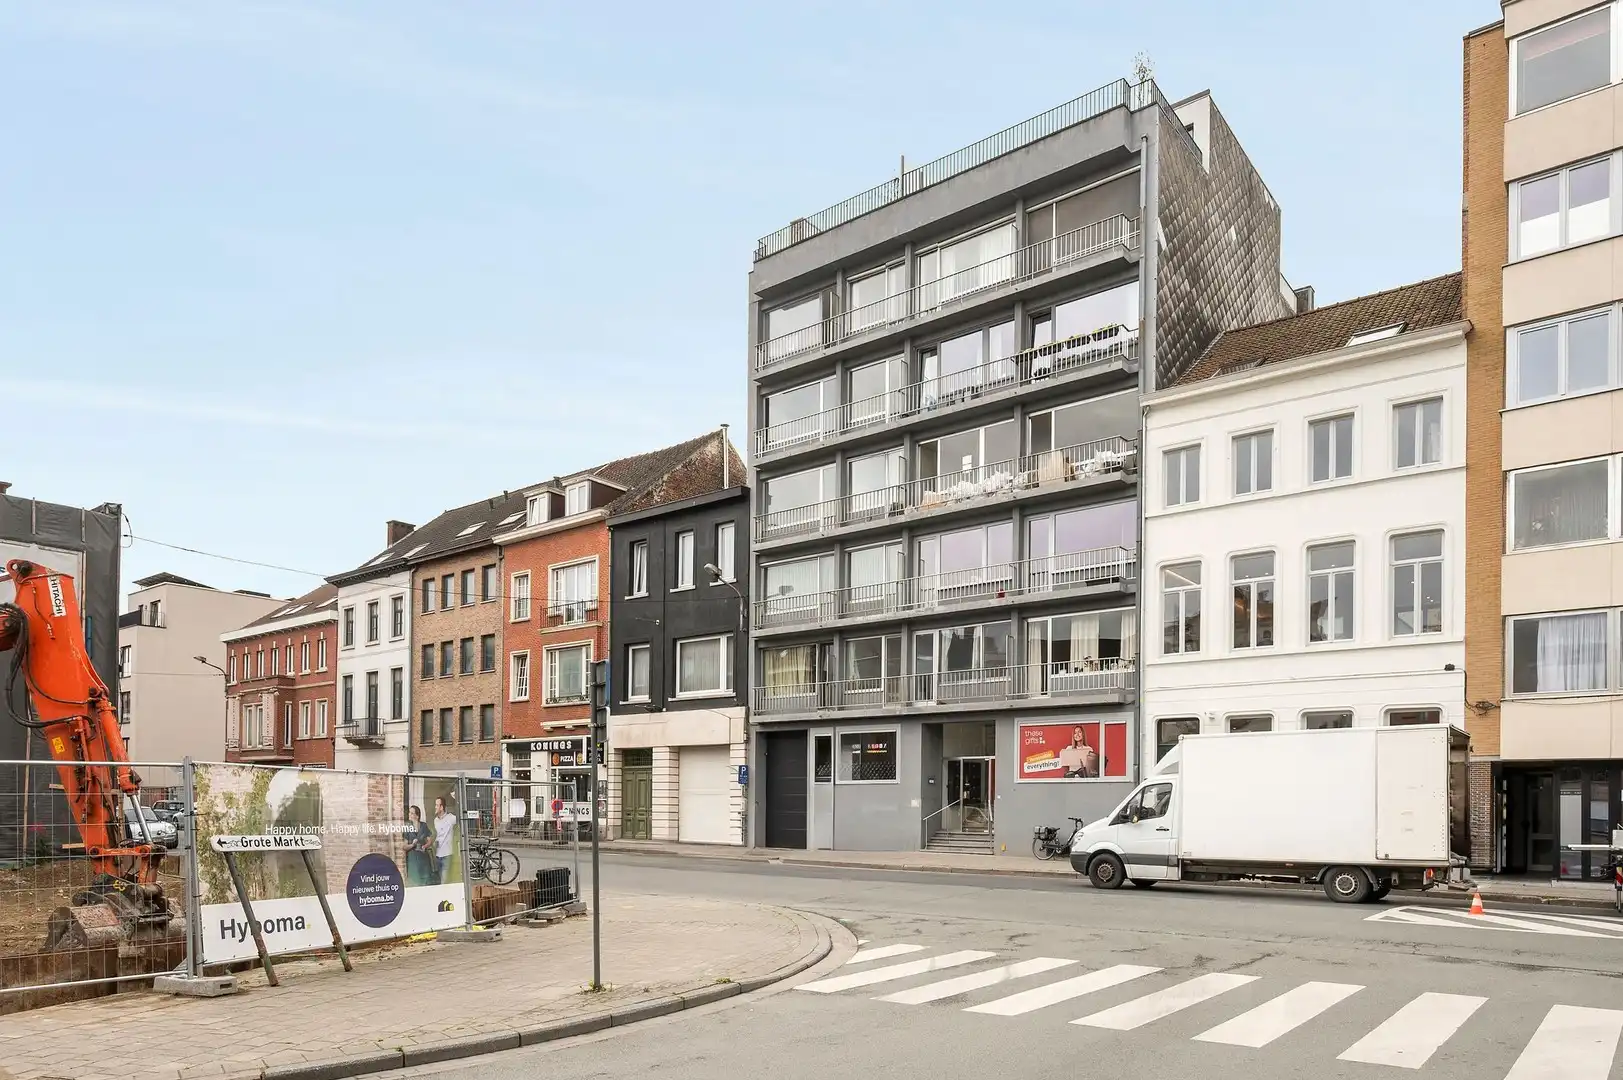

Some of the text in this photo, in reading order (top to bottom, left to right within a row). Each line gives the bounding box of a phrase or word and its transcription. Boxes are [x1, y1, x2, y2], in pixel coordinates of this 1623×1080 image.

[51, 578, 62, 614] HITACHI
[530, 741, 572, 751] KONINGS
[493, 766, 499, 775] P
[741, 766, 747, 775] P
[265, 824, 298, 836] Happy
[330, 823, 361, 836] Happy
[378, 823, 417, 836] Hyboma.
[240, 836, 305, 848] Grote Markt
[360, 874, 390, 884] Vind jouw
[352, 884, 399, 894] nieuwe thuis op
[359, 894, 394, 905] hyboma.be
